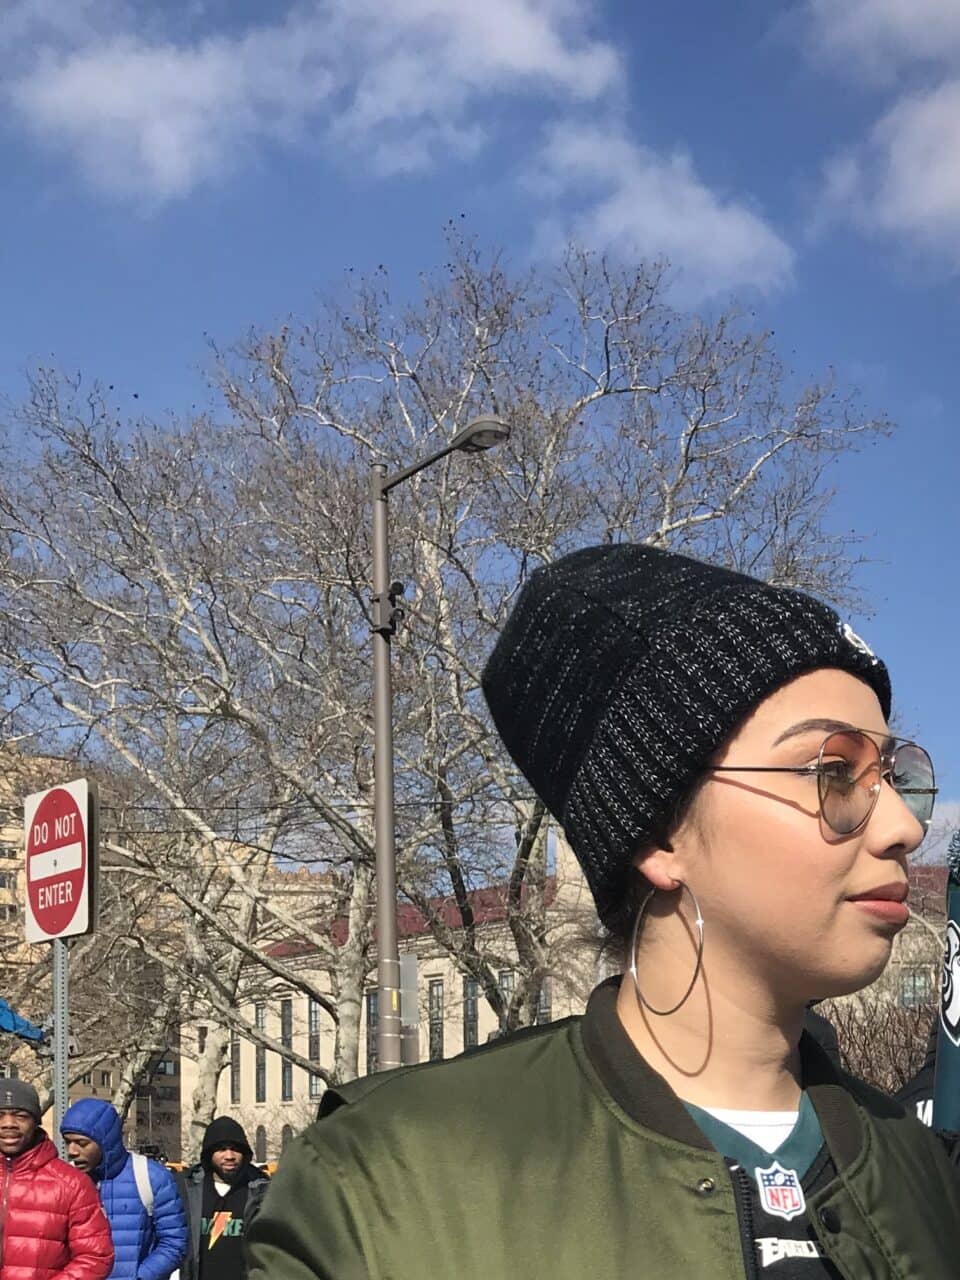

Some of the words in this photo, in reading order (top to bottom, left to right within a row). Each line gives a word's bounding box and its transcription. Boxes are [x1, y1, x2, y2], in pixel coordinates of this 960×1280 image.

[33, 822, 49, 847] DO
[54, 812, 77, 841] NOT
[38, 880, 73, 910] ENTER
[768, 1188, 800, 1210] NFL
[200, 1217, 244, 1237] NKE
